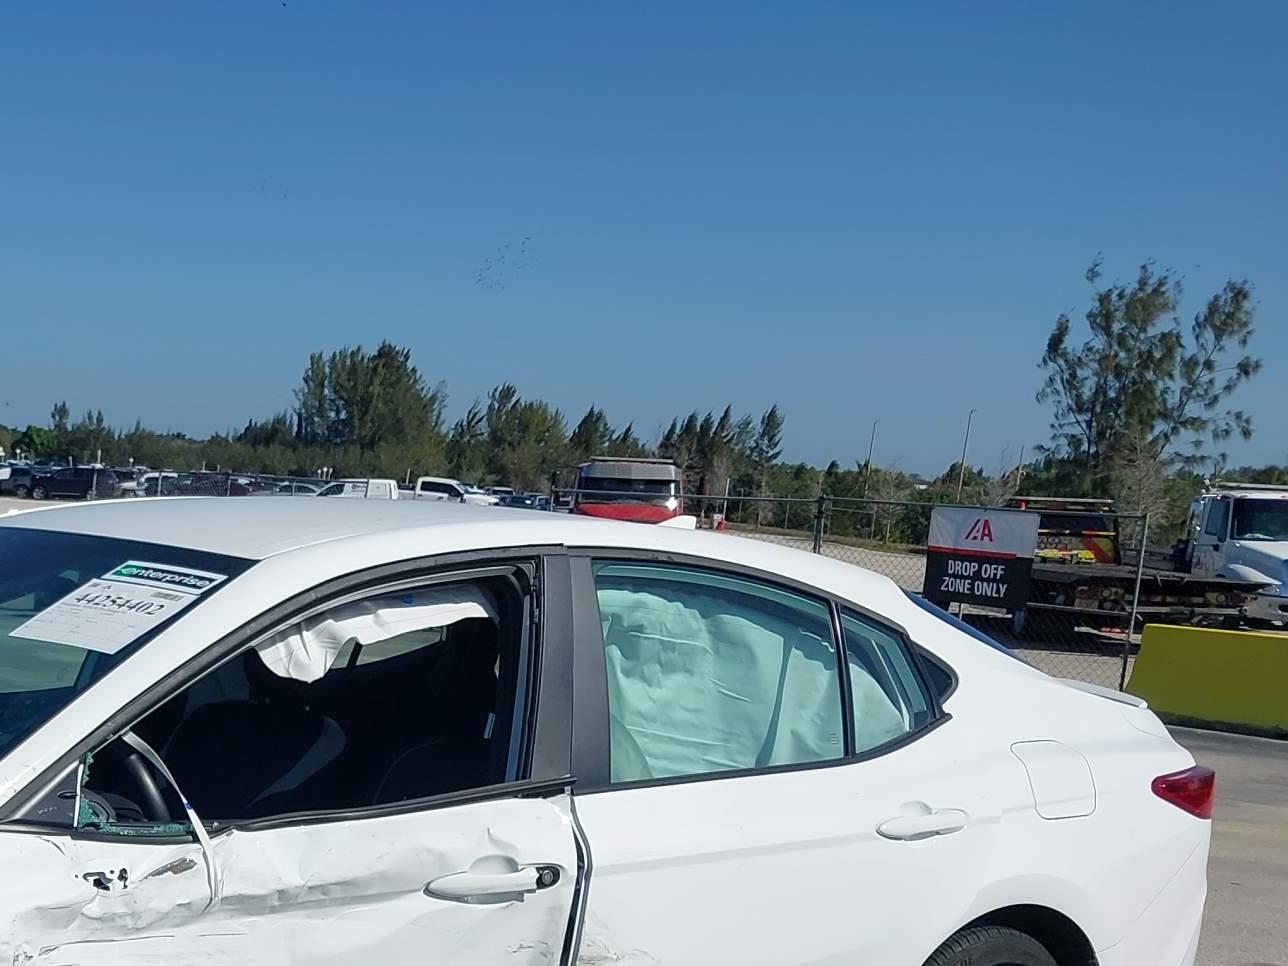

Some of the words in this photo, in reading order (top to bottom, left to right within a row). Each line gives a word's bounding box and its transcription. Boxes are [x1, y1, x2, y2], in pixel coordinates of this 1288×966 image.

[120, 567, 210, 588] enterprise
[948, 560, 978, 577] DROP
[981, 563, 1005, 579] OFF
[940, 576, 972, 594] ZONE
[974, 581, 1008, 598] ONLY
[75, 592, 167, 616] 44254402
